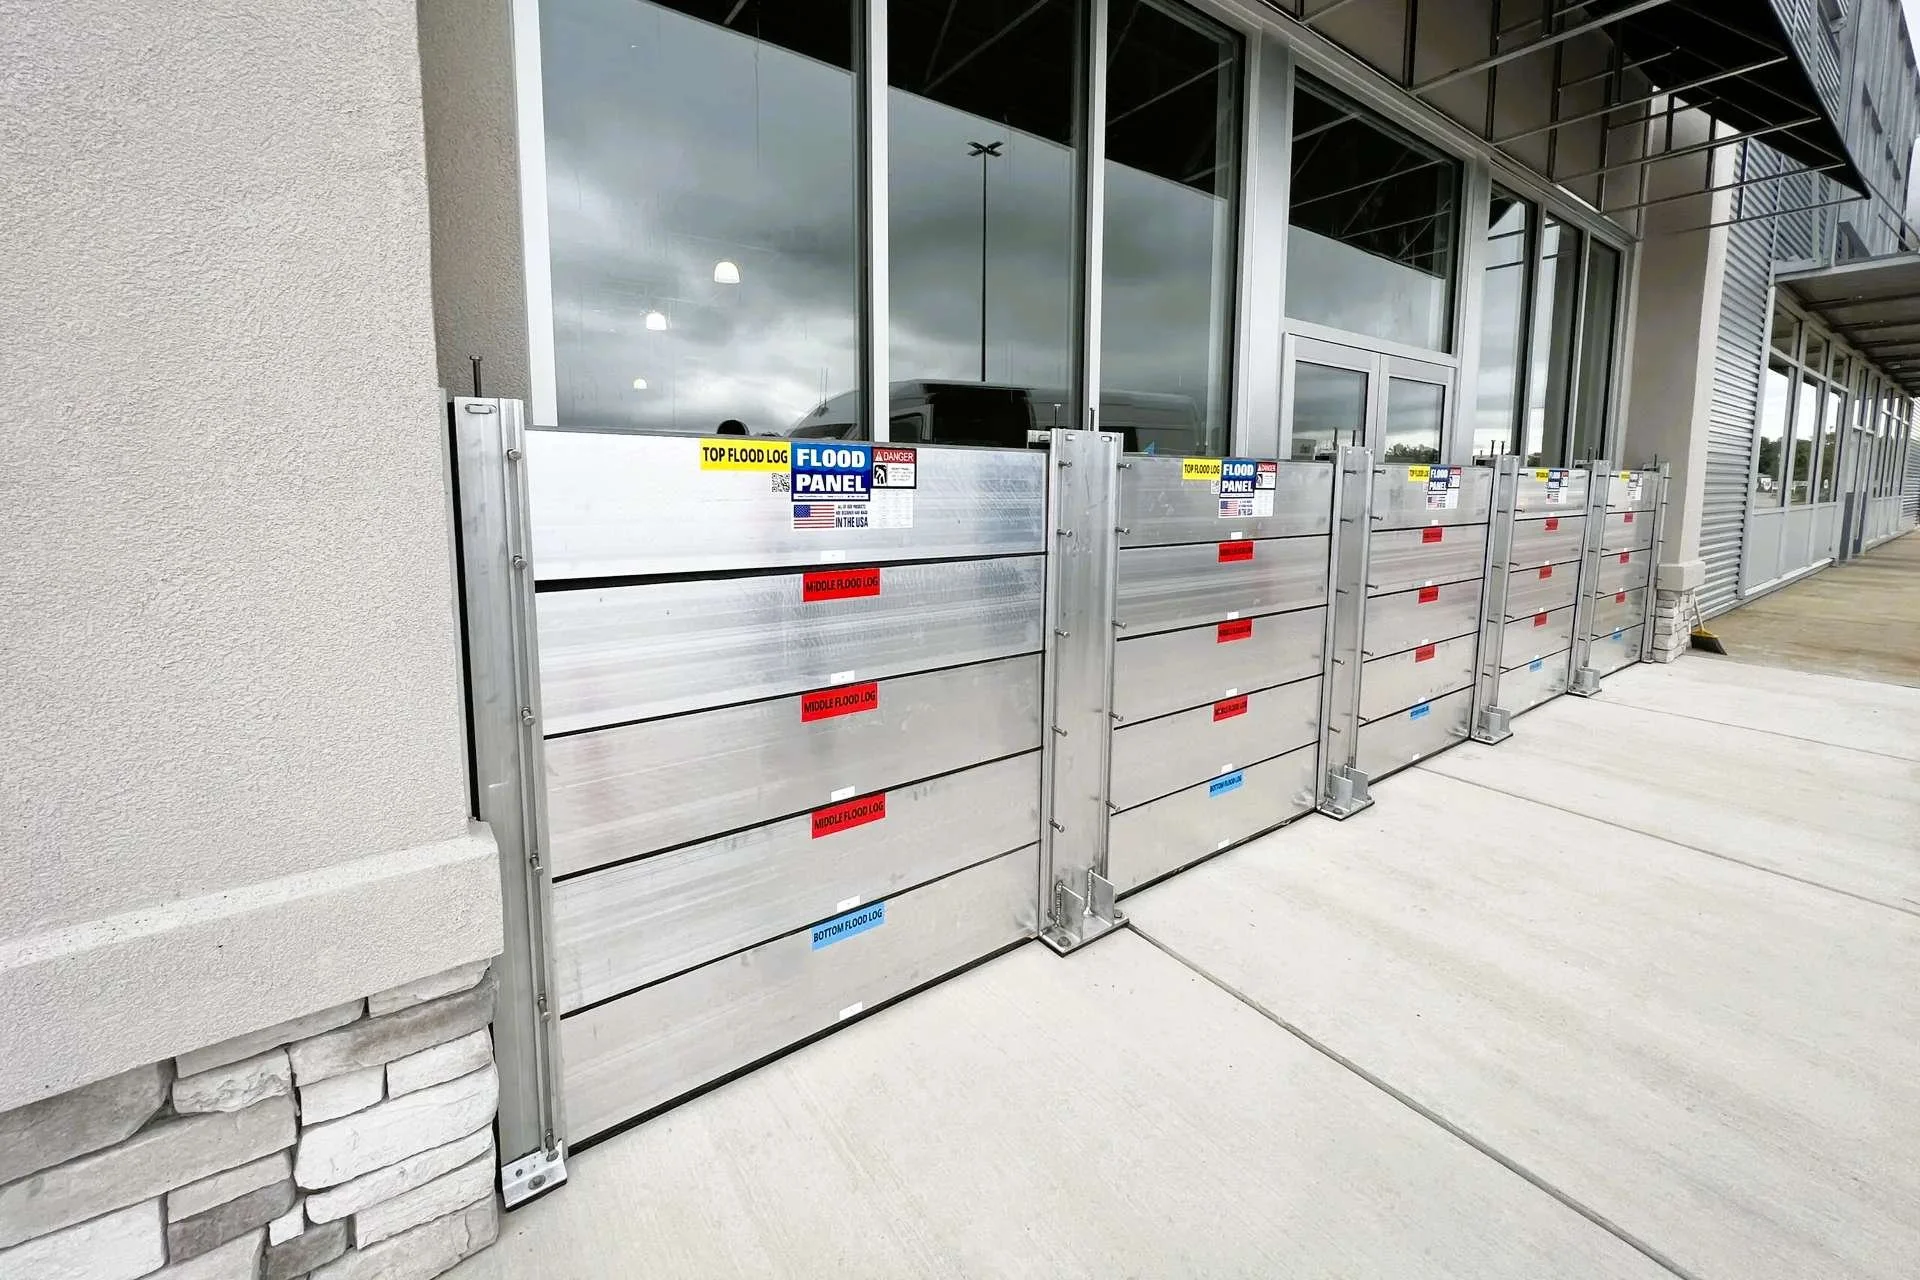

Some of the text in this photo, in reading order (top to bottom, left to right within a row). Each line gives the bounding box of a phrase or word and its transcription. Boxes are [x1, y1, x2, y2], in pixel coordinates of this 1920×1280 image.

[703, 446, 788, 464] TOP FLOOD LOG
[797, 448, 866, 468] FLOOD
[883, 451, 914, 462] DANGER
[1184, 464, 1220, 474] TOP FLOOD LOG
[1223, 464, 1254, 476] FLOOD
[796, 474, 866, 492] PANEL
[1222, 480, 1253, 492] PANEL
[836, 516, 868, 528] IN THE USA
[806, 576, 878, 592] MIDDLE FLOOD LOG
[804, 690, 876, 712] MIDDLE FLOOD LOG
[815, 801, 884, 830] MIDDLE FLOOD LOG
[814, 909, 882, 942] BOTTOM FLOOD LOG
